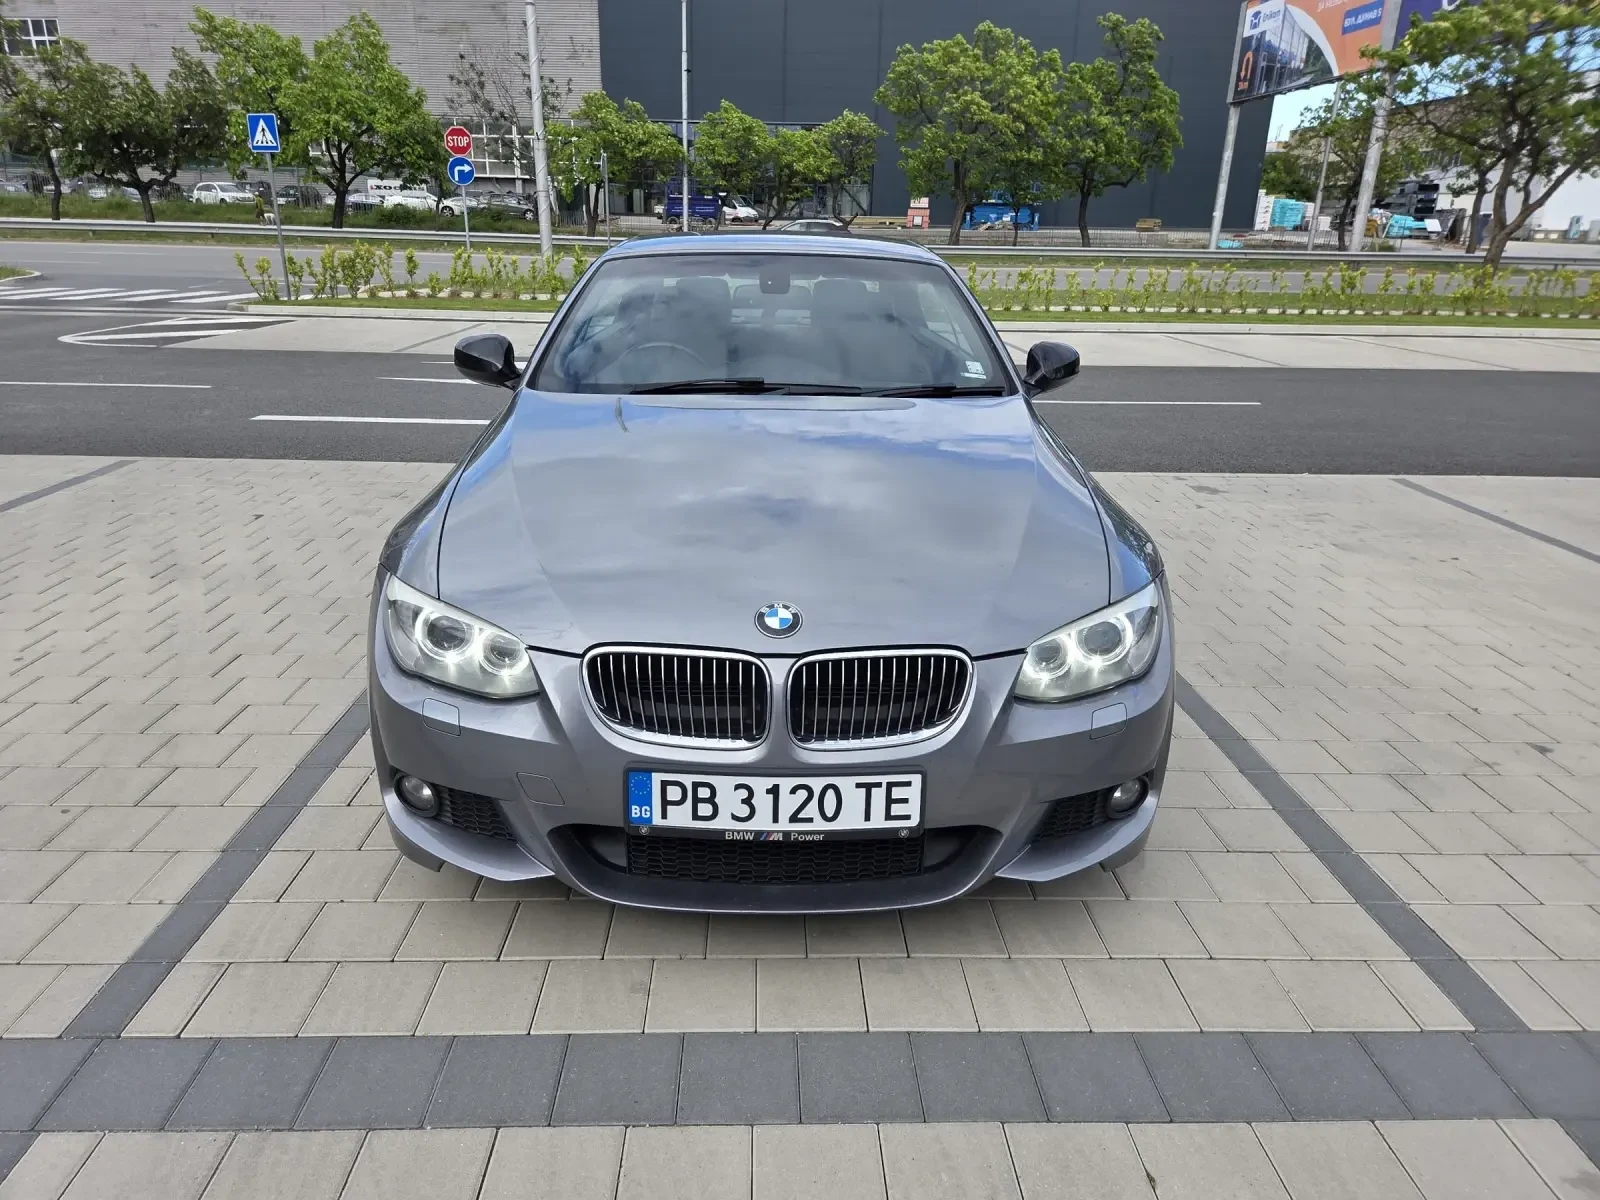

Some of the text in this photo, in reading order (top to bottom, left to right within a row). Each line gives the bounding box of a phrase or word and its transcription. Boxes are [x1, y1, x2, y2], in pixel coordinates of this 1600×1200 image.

[447, 135, 470, 148] STOP
[760, 603, 798, 614] BMW
[660, 779, 912, 824] PB 3120 TE
[631, 805, 651, 818] BG
[725, 831, 755, 841] BMW
[790, 832, 825, 841] Power
